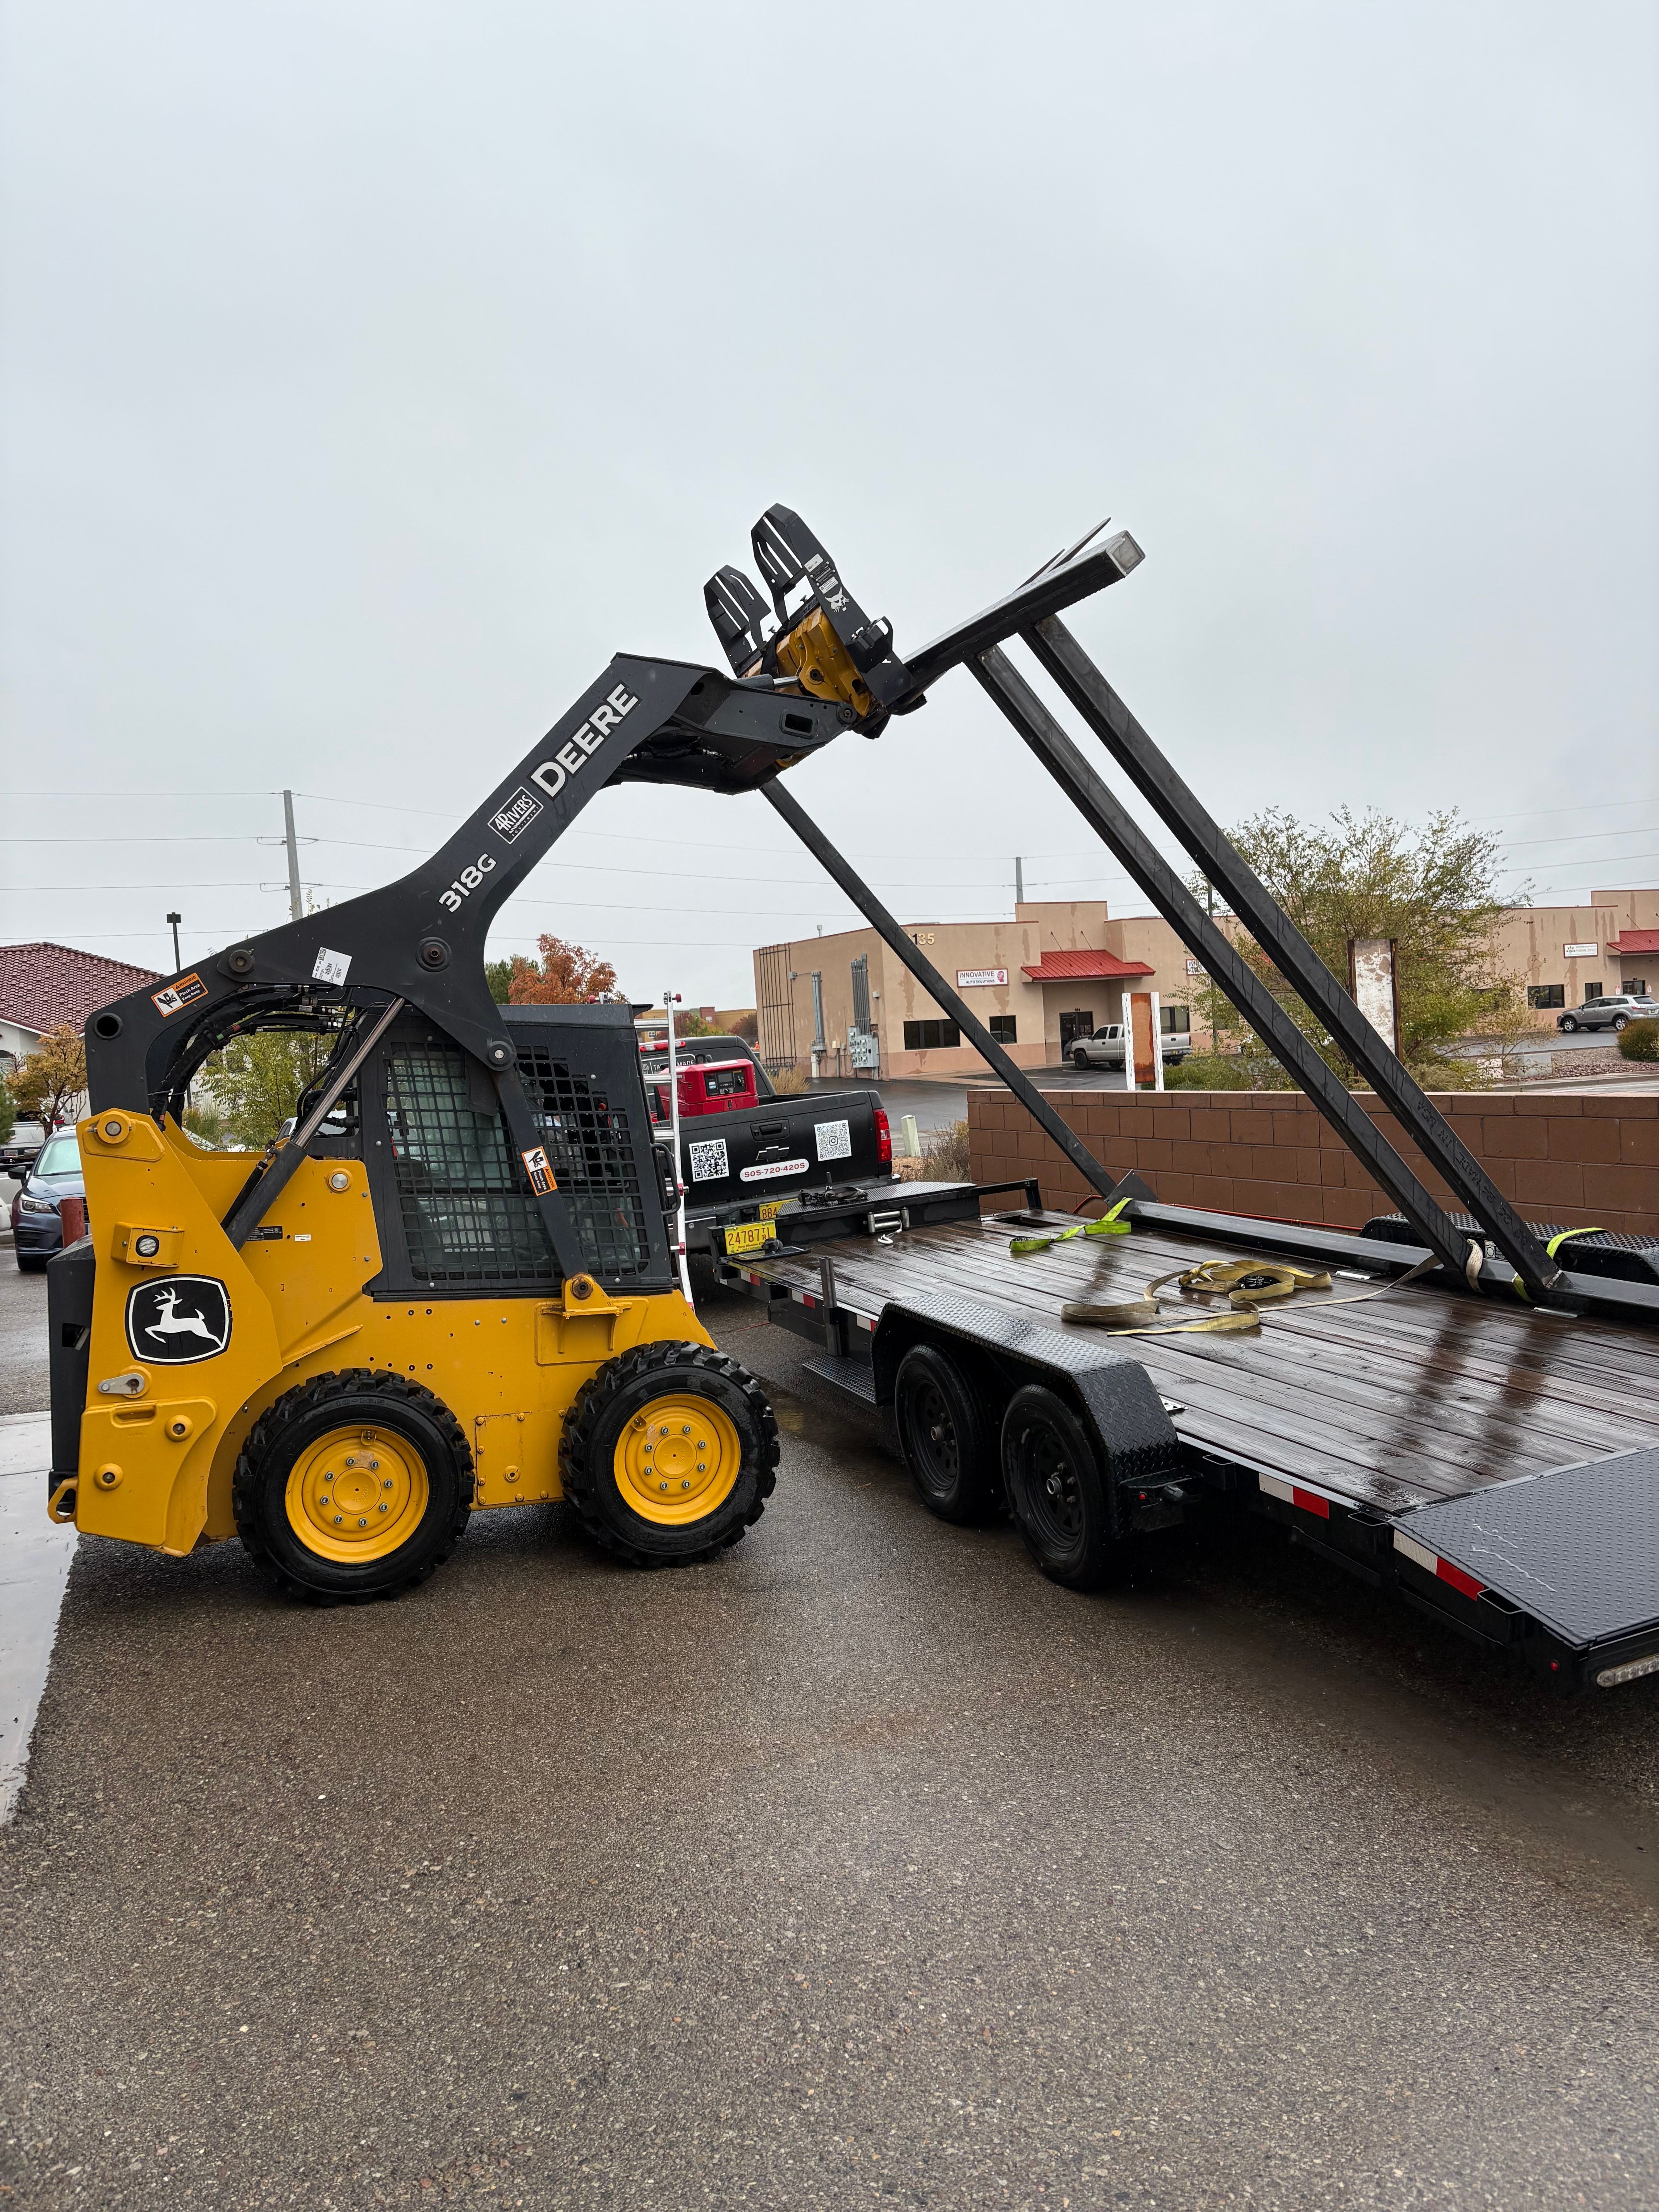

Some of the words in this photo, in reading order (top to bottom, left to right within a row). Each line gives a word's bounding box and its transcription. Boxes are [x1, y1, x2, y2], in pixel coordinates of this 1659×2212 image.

[531, 684, 639, 797] DEERE
[439, 853, 497, 912] 318G
[179, 989, 191, 997] Pinch
[744, 1163, 805, 1178] 505-720-4205
